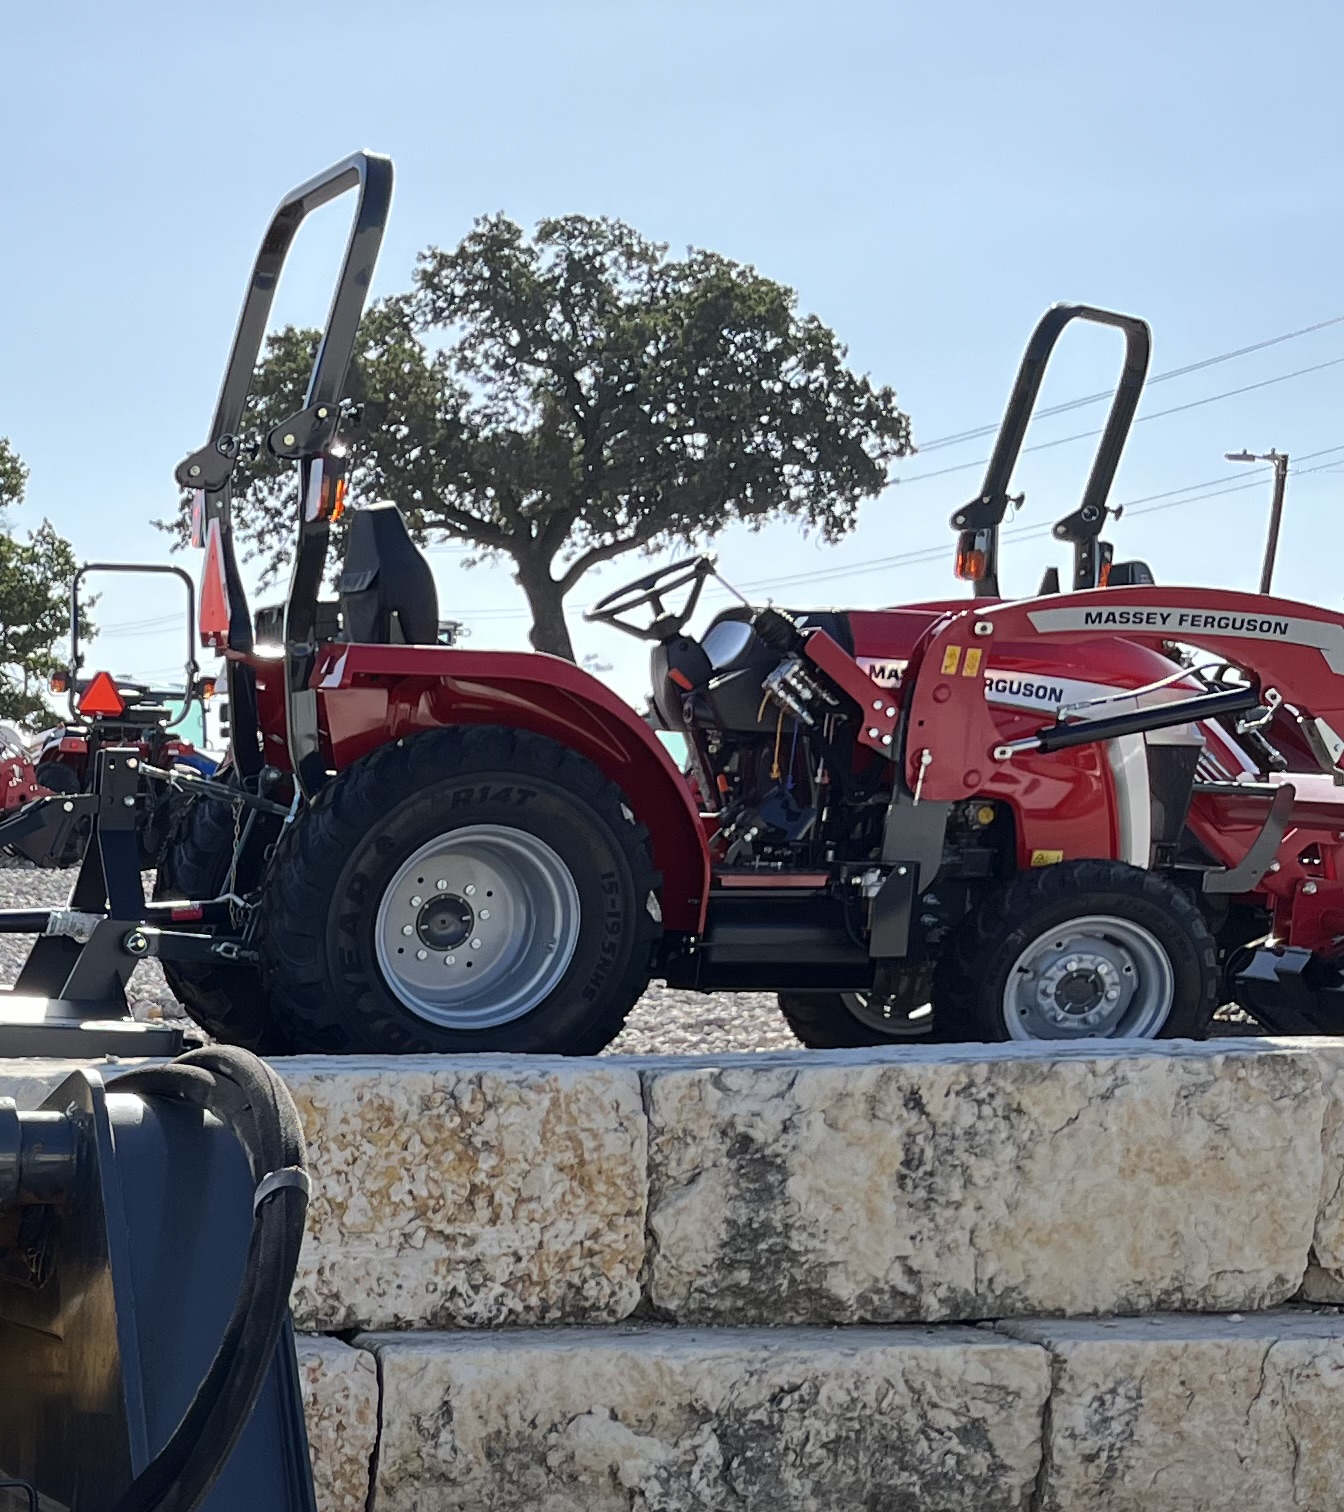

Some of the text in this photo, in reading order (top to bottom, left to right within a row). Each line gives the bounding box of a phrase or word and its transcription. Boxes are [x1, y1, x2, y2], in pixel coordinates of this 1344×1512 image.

[1084, 611, 1289, 635] MASSEY FERGUSON
[984, 677, 1064, 704] RGUSON
